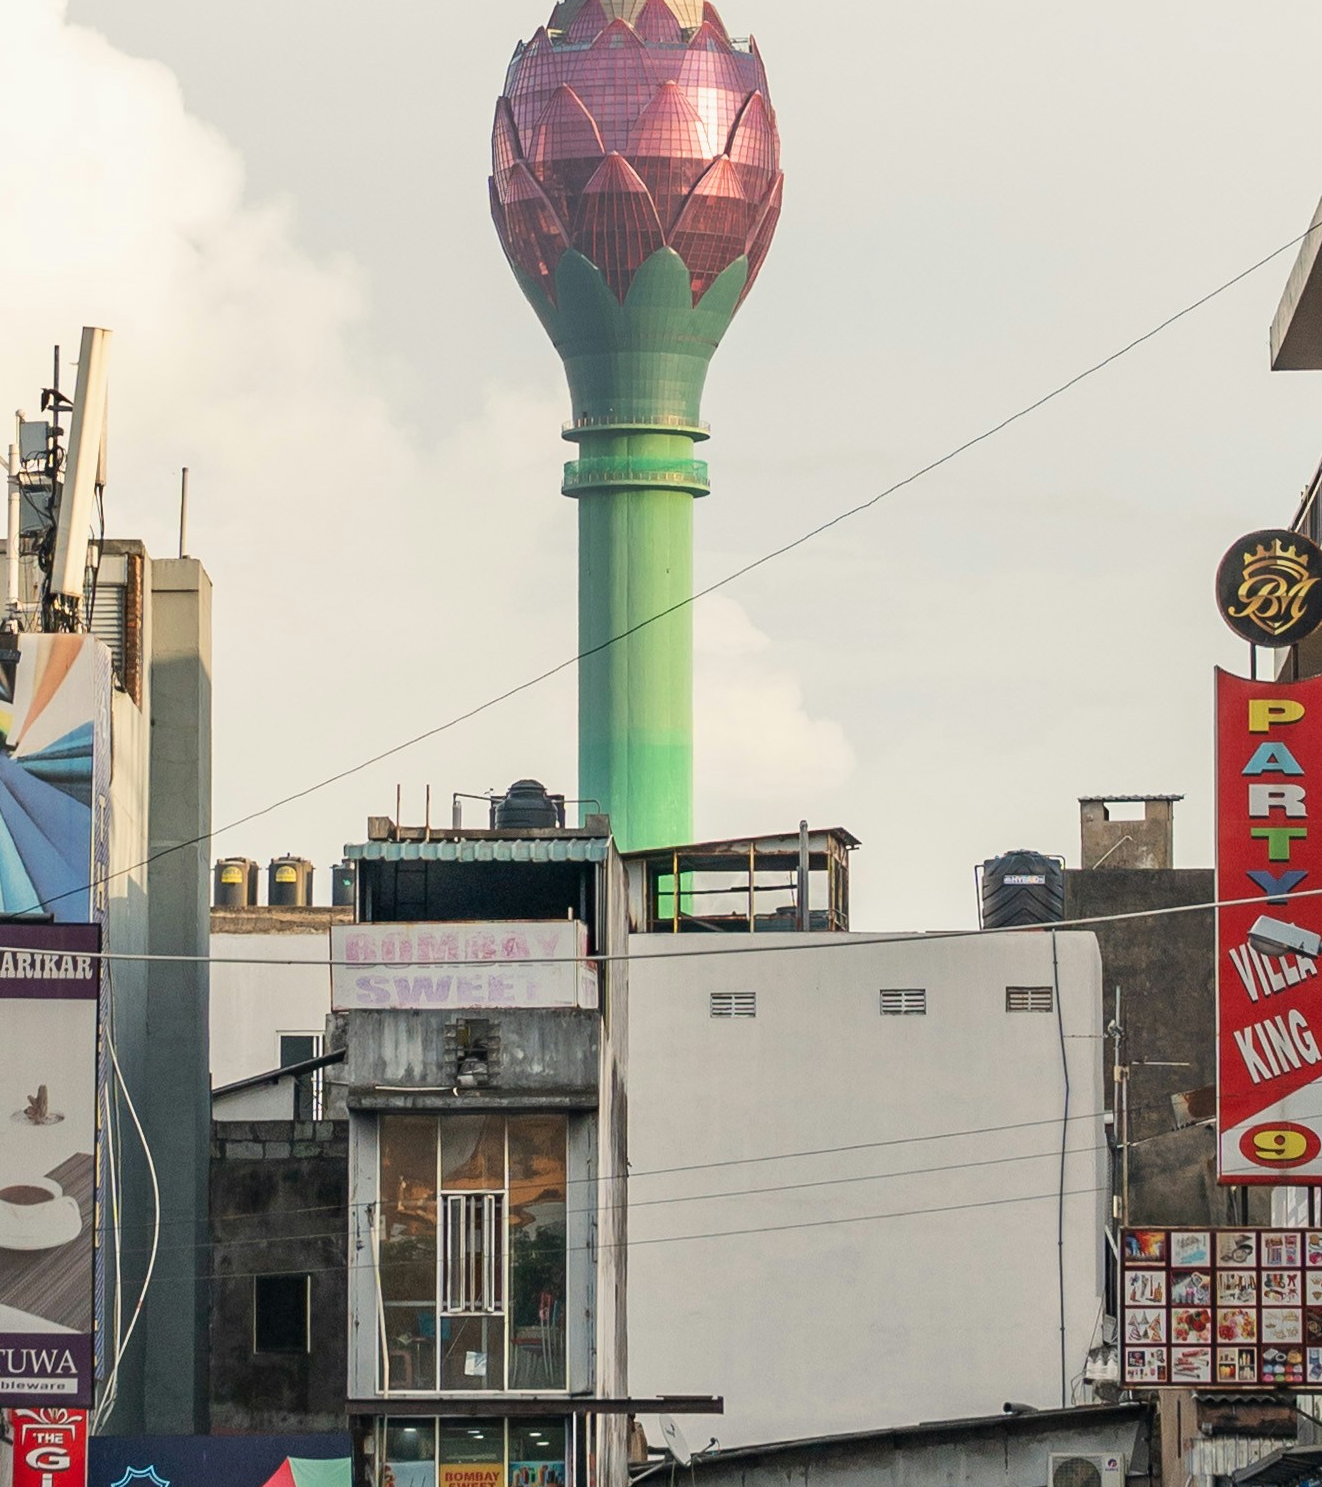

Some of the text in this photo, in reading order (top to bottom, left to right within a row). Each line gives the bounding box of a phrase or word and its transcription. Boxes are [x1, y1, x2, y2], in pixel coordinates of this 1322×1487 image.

[1241, 699, 1309, 905] PARTY
[345, 931, 562, 968] BOMBAY
[355, 974, 540, 1004] SWEET
[1234, 1009, 1322, 1084] KING
[1253, 1130, 1308, 1160] 9
[33, 1432, 64, 1444] THE
[444, 1471, 500, 1482] BOMBAY
